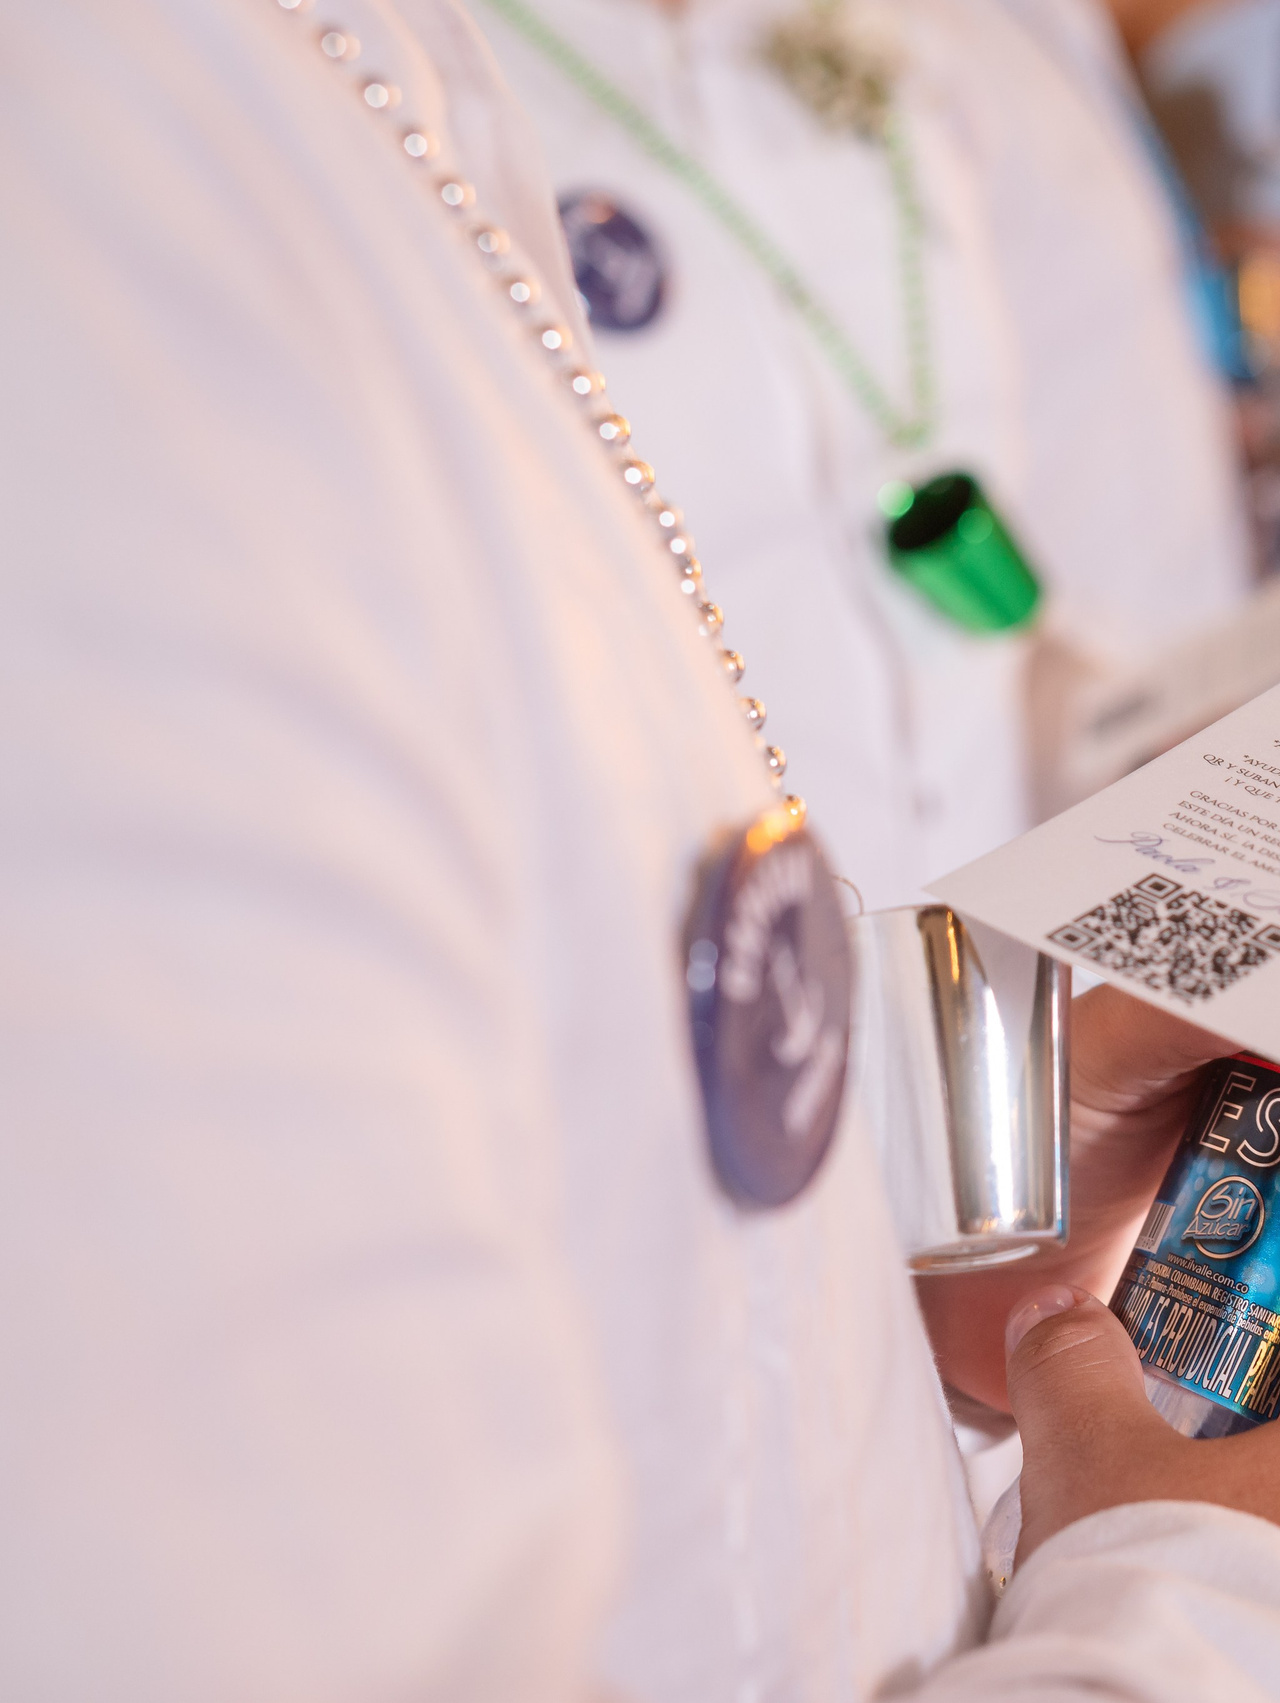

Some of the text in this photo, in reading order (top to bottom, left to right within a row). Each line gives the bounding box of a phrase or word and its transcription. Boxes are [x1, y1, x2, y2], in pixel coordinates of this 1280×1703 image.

[1202, 753, 1225, 767] QR
[1225, 762, 1239, 770] Y
[1189, 790, 1250, 818] GRACIAS
[1247, 814, 1279, 831] POR
[1232, 778, 1246, 787] Y
[1244, 785, 1275, 800] QUE
[1167, 1253, 1249, 1294] www.ilvalle.com.co
[1168, 1267, 1213, 1298] COLOMBIANA
[1209, 1285, 1250, 1313] REGISTRO
[1121, 1285, 1155, 1343] COHOL
[1138, 1296, 1170, 1359] ES
[1190, 1294, 1202, 1308] el
[1196, 1296, 1229, 1323] expendio
[1225, 1309, 1239, 1324] de
[1235, 1313, 1266, 1337] bebidas
[1148, 1302, 1252, 1398] PERJUDICIAL
